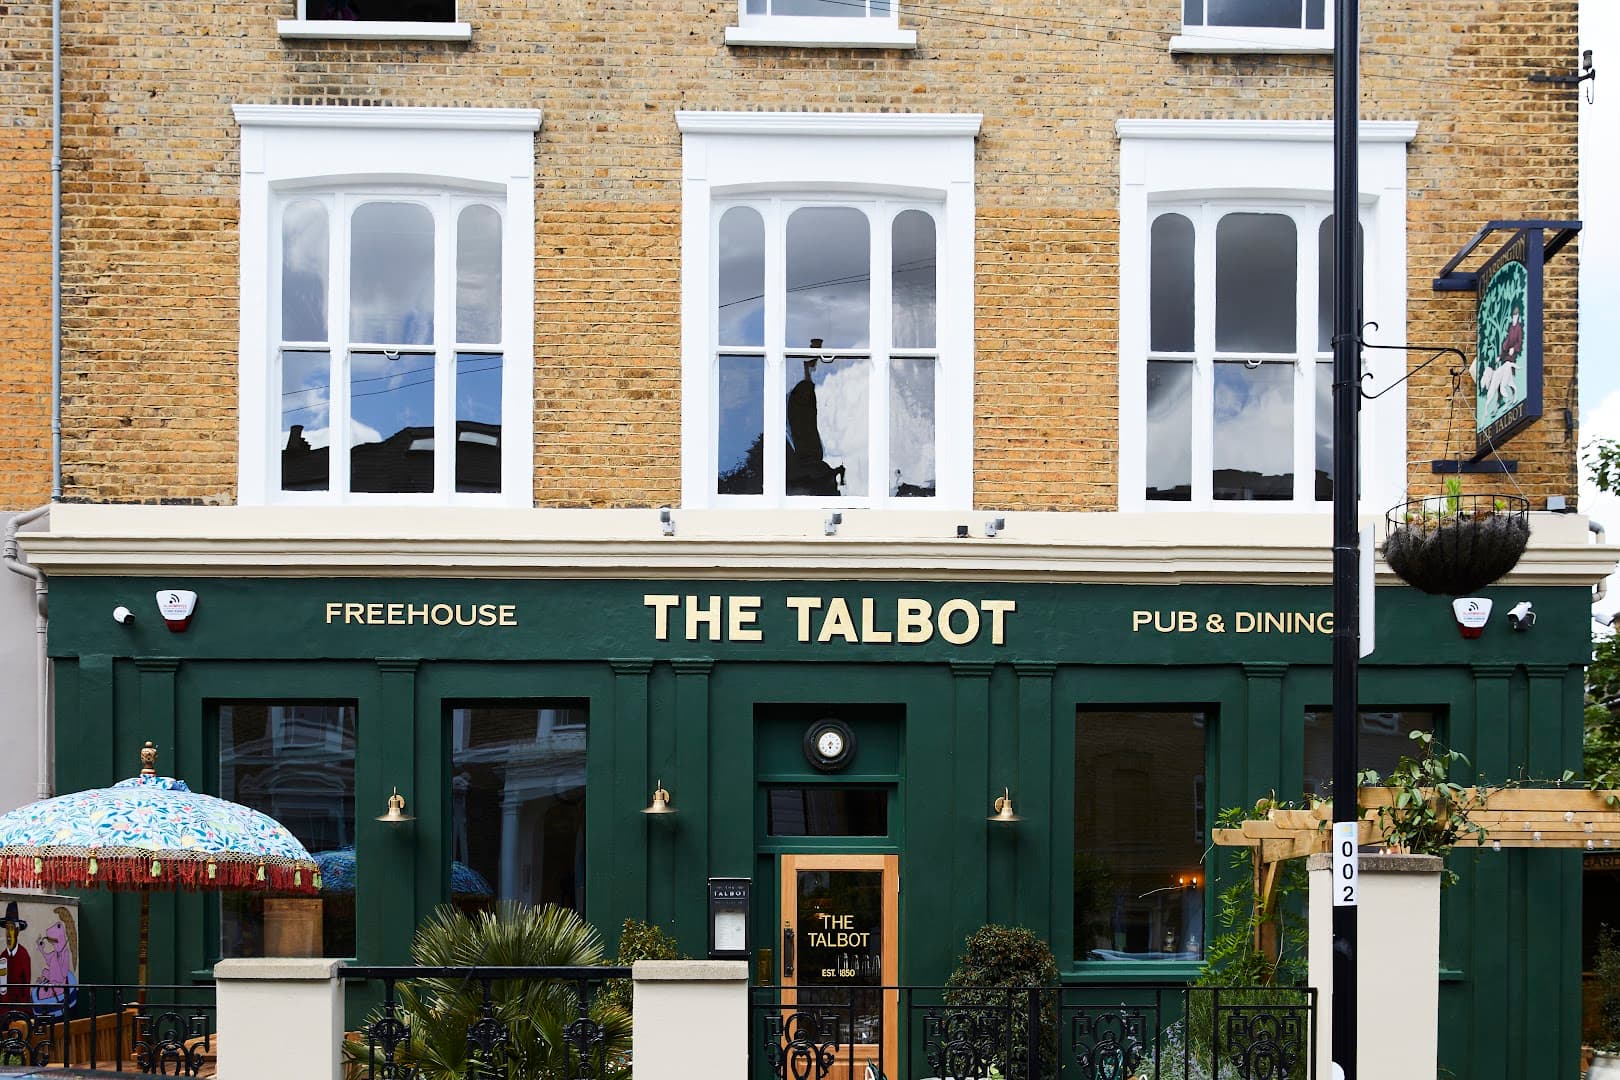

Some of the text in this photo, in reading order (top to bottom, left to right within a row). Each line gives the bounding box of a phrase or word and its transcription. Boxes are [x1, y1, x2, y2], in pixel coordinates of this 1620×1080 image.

[1495, 403, 1524, 434] TALBOT
[326, 603, 518, 626] FREEHOUSE
[643, 594, 1017, 646] THE TALBOT
[1132, 611, 1334, 635] PUB & DINING
[823, 914, 855, 930] THE
[807, 932, 870, 948] TALBOT
